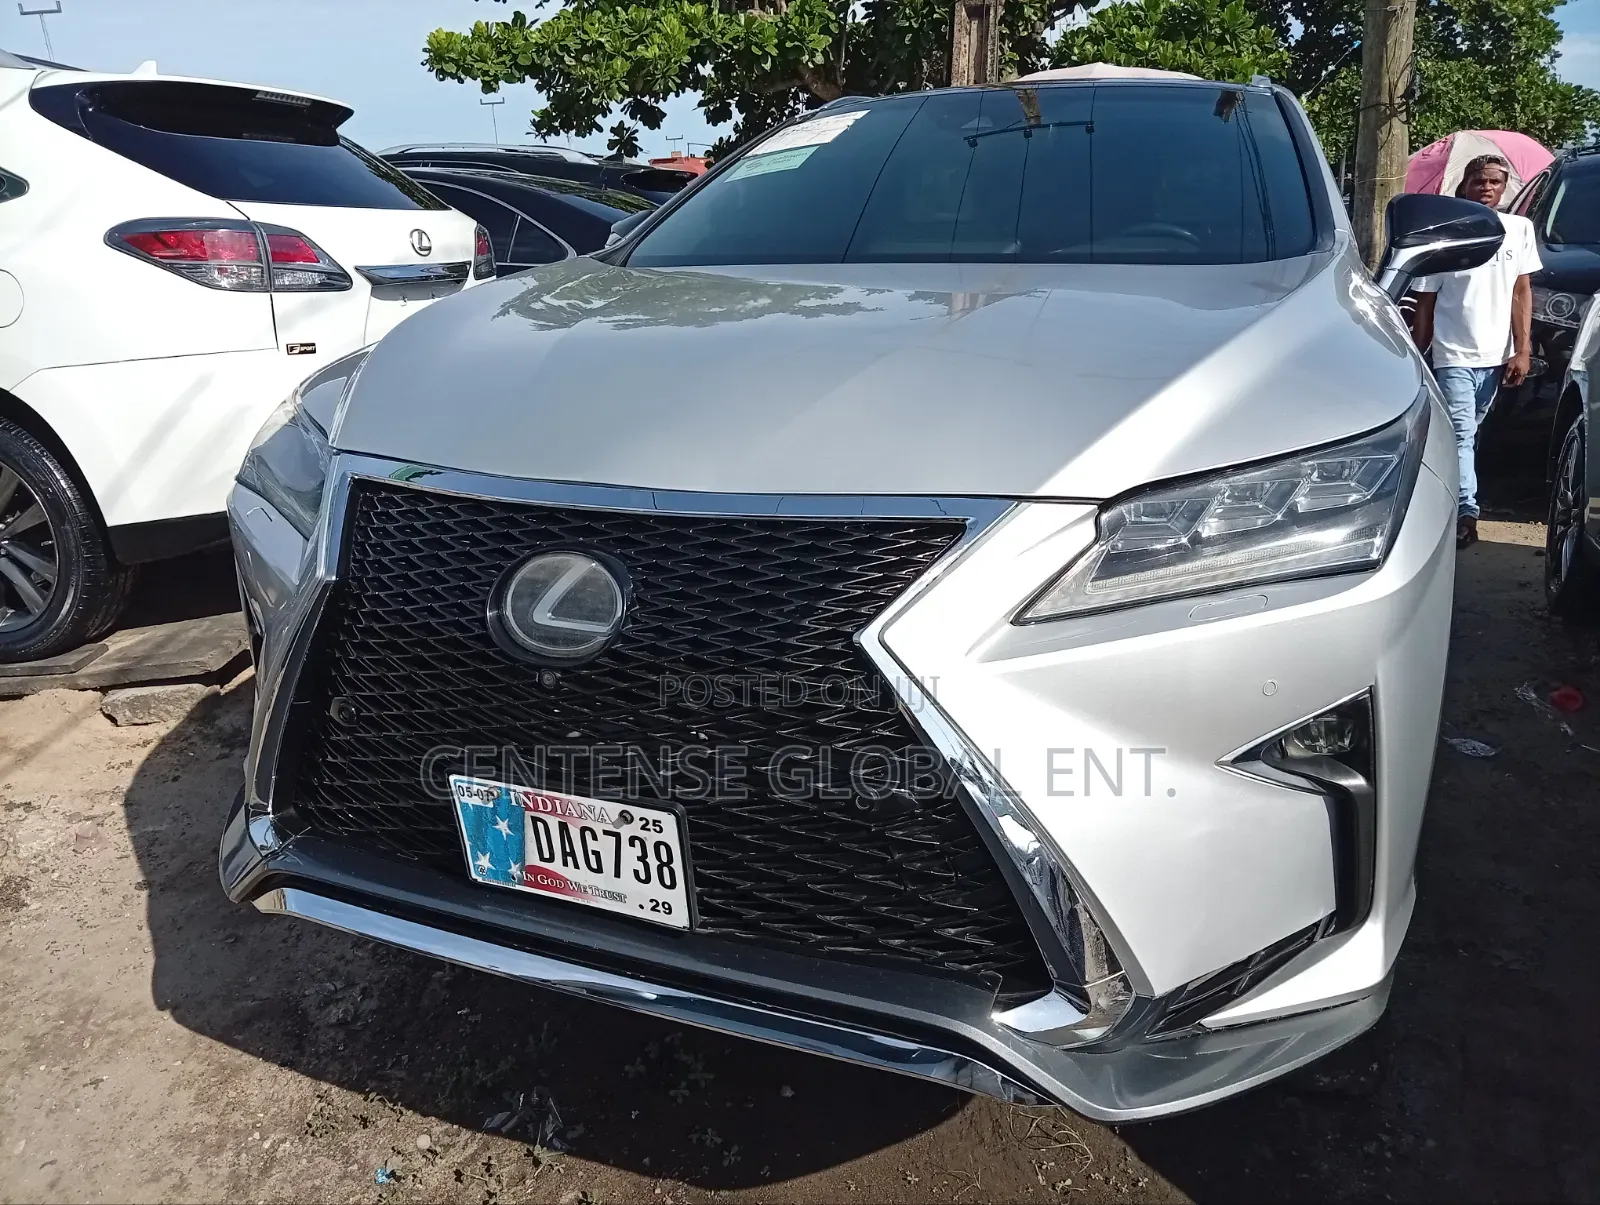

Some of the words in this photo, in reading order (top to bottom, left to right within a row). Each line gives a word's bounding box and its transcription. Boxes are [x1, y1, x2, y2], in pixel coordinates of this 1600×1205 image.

[509, 789, 614, 825] INDIANA
[639, 816, 664, 834] 25
[530, 815, 677, 890] DAG738
